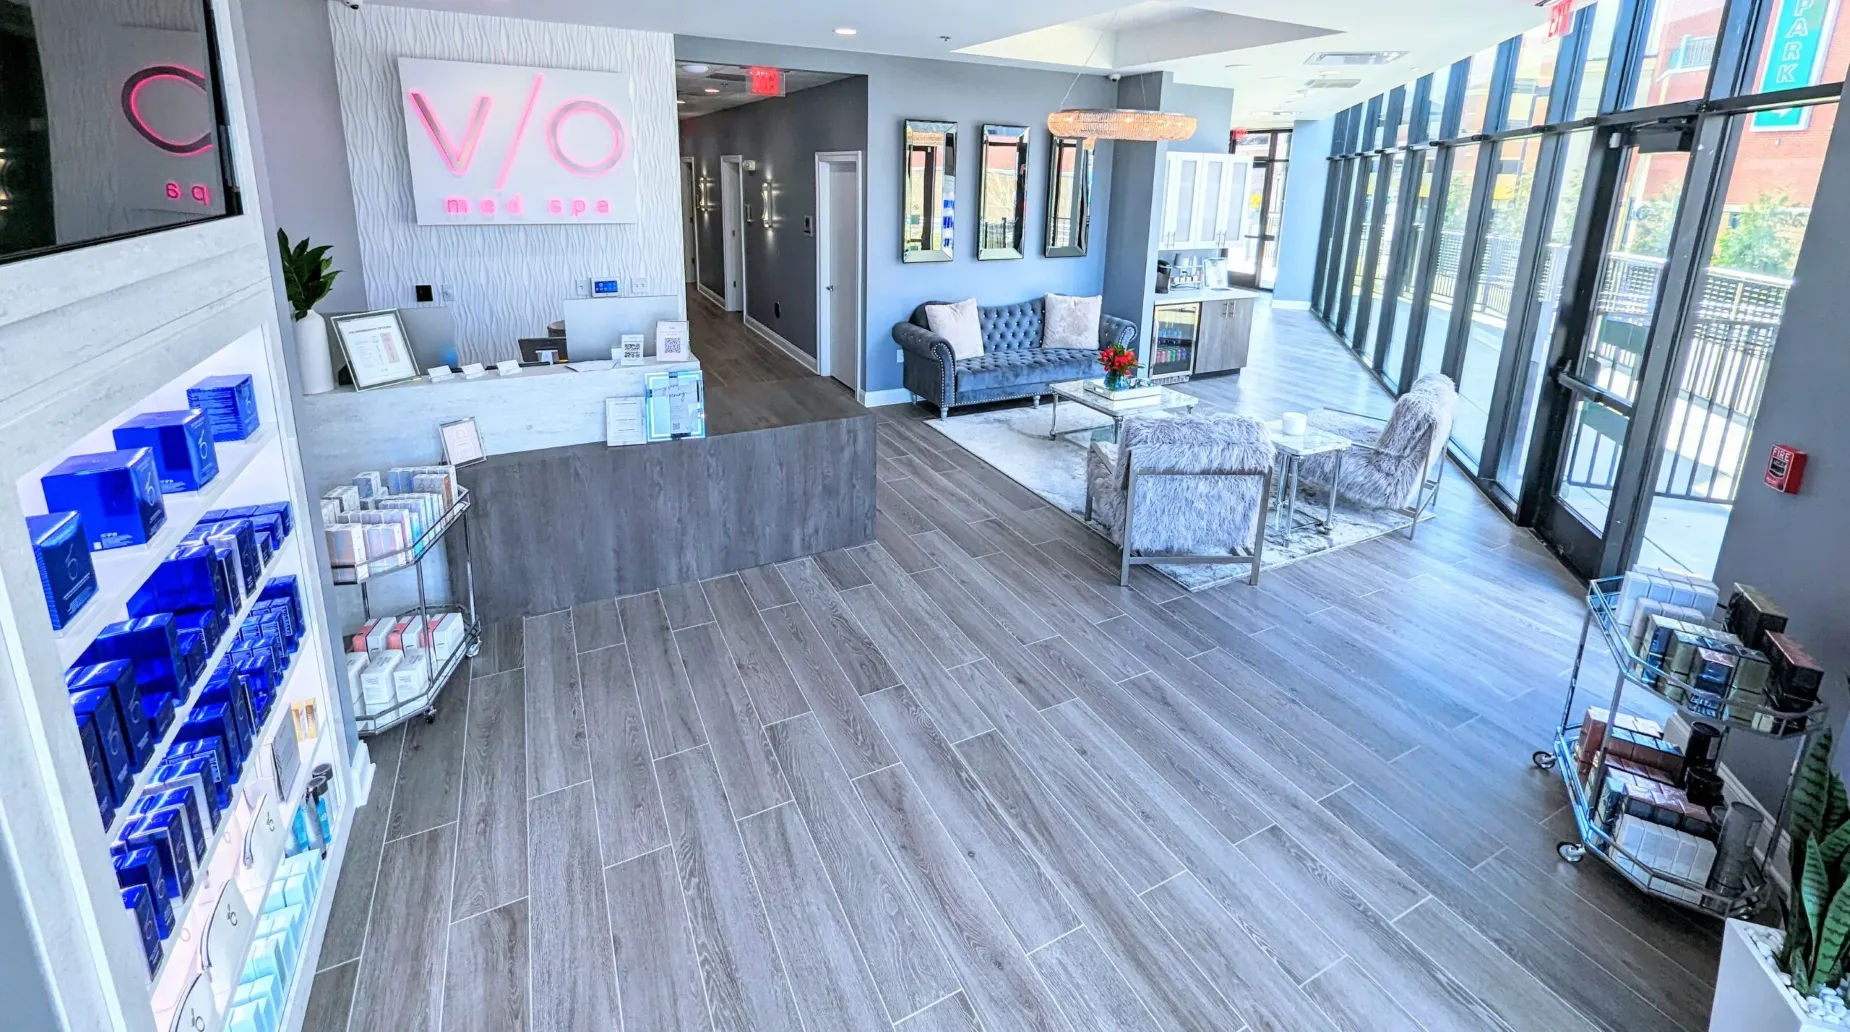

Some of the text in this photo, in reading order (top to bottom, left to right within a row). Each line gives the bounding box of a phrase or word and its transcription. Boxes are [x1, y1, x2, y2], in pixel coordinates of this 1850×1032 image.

[1776, 0, 1814, 83] PARK
[445, 195, 612, 217] med spa
[1772, 447, 1791, 462] FIRE
